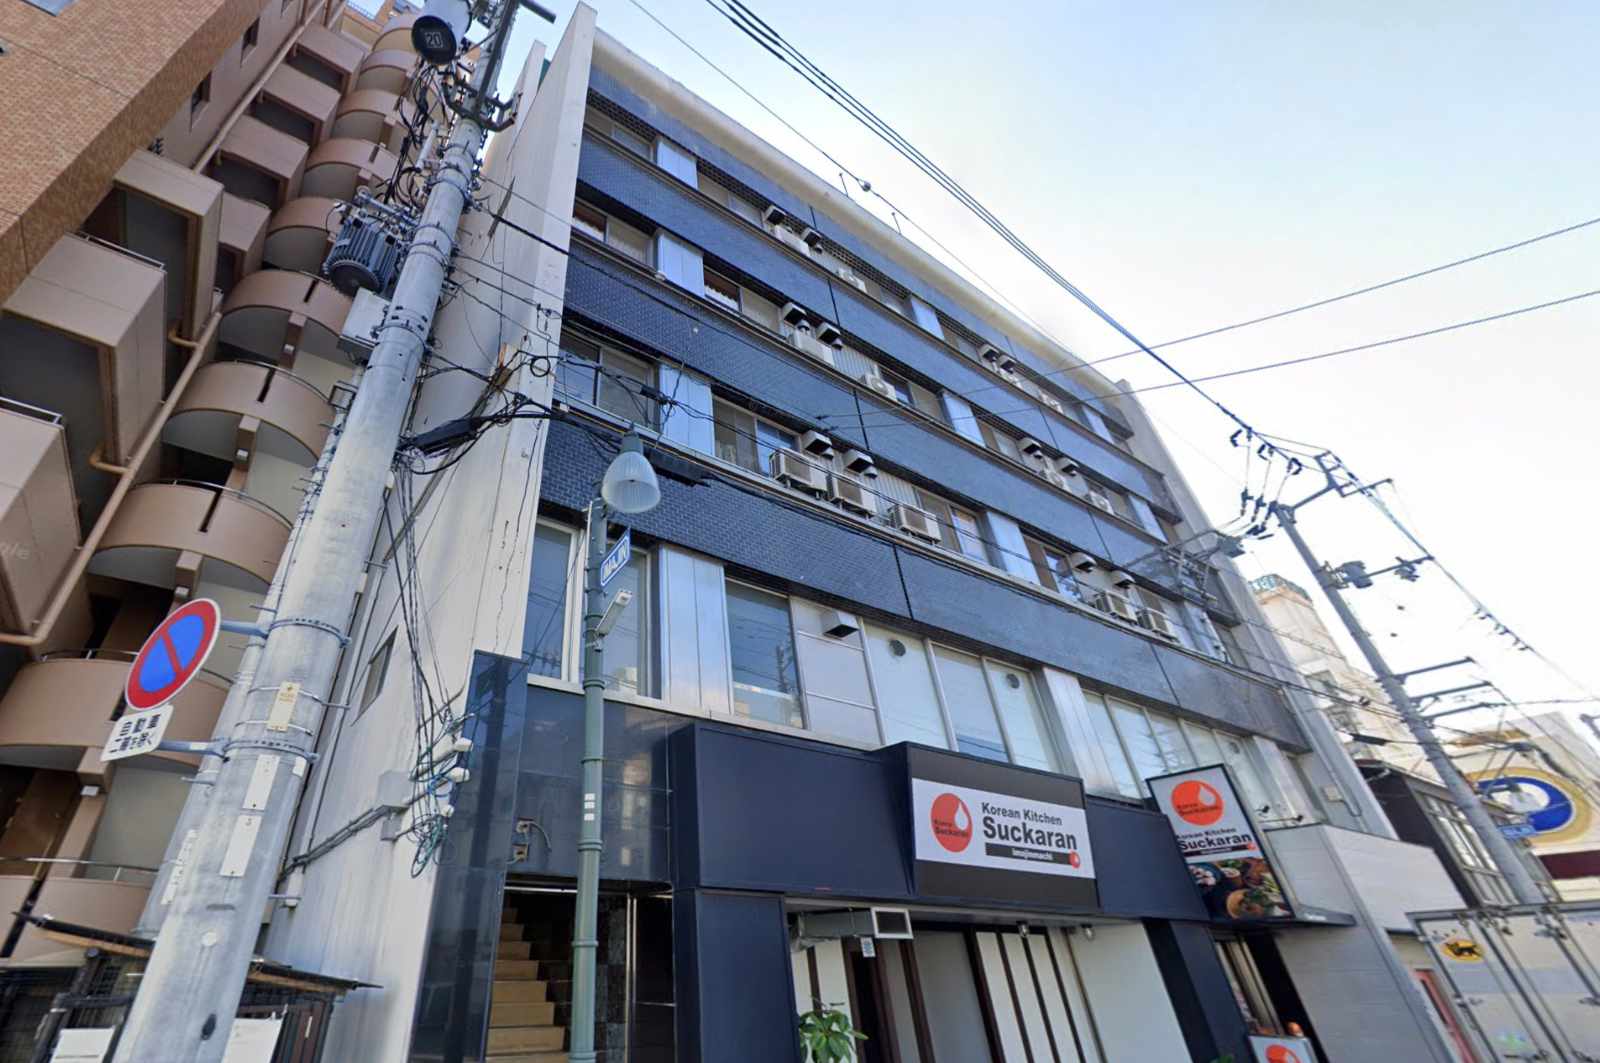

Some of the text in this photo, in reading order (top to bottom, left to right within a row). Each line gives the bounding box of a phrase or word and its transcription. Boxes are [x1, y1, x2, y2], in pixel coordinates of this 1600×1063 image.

[424, 31, 444, 49] 20
[981, 802, 1063, 826] Korean Kitchen
[982, 816, 1077, 850] Suckaran
[1204, 828, 1236, 837] Kitchen
[1177, 834, 1252, 850] Suckaran
